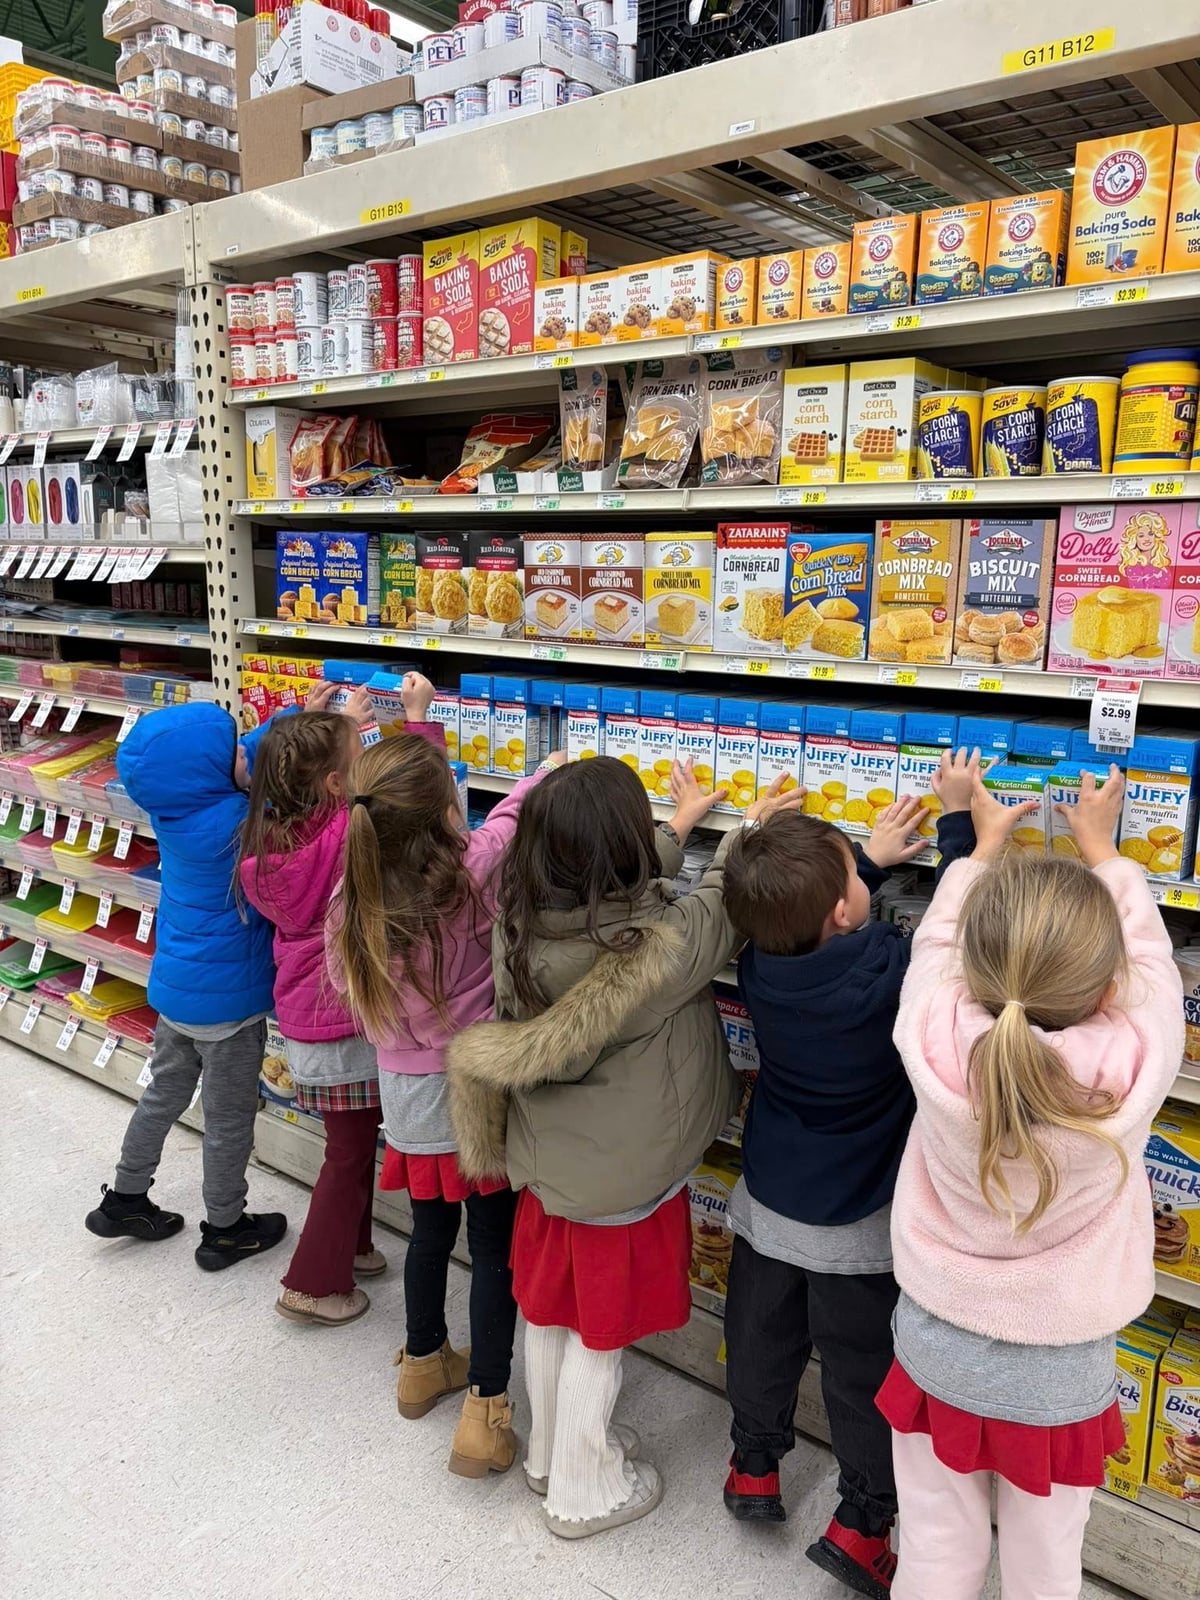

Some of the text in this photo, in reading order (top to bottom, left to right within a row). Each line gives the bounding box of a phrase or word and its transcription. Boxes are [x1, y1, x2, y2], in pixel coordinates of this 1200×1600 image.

[1023, 35, 1095, 66] G11 B12
[425, 107, 447, 121] PET
[1096, 165, 1108, 187] ARM
[1116, 154, 1144, 181] HAMMER
[370, 201, 403, 220] G11 B13
[1104, 210, 1126, 223] pure
[1075, 216, 1156, 238] Baking Soda
[484, 239, 507, 258] Save
[999, 245, 1042, 258] Baking Soda
[1086, 250, 1104, 259] 100+
[929, 255, 970, 266] Baking Soda
[1086, 256, 1104, 266] USES
[489, 253, 527, 284] BAKING
[434, 264, 471, 293] BAKING
[501, 270, 530, 296] SODA
[670, 276, 697, 289] baking
[445, 281, 472, 305] SODA
[626, 285, 651, 297] baking
[673, 286, 692, 296] soda
[807, 283, 842, 296] Baking Soda
[1118, 288, 1136, 301] $2.39
[587, 294, 612, 305] baking
[630, 294, 647, 303] soda
[762, 292, 780, 301] Baking
[542, 300, 566, 310] baking
[546, 307, 562, 316] soda
[590, 301, 607, 311] soda
[897, 316, 912, 327] $1.29
[708, 370, 778, 391] CORN BREAD
[876, 381, 896, 389] Choice
[799, 403, 825, 413] corn
[865, 398, 893, 409] corn
[992, 396, 1018, 411] Save
[859, 408, 897, 421] starch
[1008, 409, 1035, 426] CORN
[1056, 401, 1083, 421] CORN
[794, 413, 829, 425] starch
[932, 414, 958, 431] CORN
[1047, 415, 1085, 438] STARCH
[923, 426, 960, 447] STARCH
[997, 424, 1037, 443] STARCH
[1155, 483, 1175, 495] $2.59
[1077, 510, 1111, 522] Duncan
[1080, 517, 1109, 528] Hines
[728, 527, 787, 538] ZATARAIN'S
[427, 545, 460, 553] RED LOBSTER
[900, 537, 932, 548] LOUISIANA
[989, 537, 1023, 548] LOUISIANA
[1060, 532, 1120, 563] Dolly
[492, 545, 515, 554] LOBSTER
[723, 557, 780, 573] CORNBREAD
[803, 559, 825, 573] Quick
[836, 554, 855, 565] Easy
[877, 557, 953, 578] CORNBREAD
[969, 559, 1040, 579] BISCUIT
[280, 567, 320, 577] CORN BREAD
[323, 568, 362, 579] CORN BREAD
[743, 572, 757, 582] MIX
[790, 563, 863, 594] Corn Bread
[1059, 574, 1121, 583] CORNBREAD
[531, 575, 571, 586] CORNBREAD MIX
[588, 576, 633, 589] CORNBREAD MIX
[653, 578, 701, 589] CORNBREAD MIX
[899, 575, 926, 590] MIX
[988, 576, 1016, 592] MIX
[827, 585, 848, 598] Mix
[894, 592, 930, 601] HOMESTYLE
[980, 594, 1022, 604] BUTTERMILK
[248, 685, 264, 696] CORN
[431, 703, 458, 716] JIFFY
[461, 707, 488, 720] JIFFY
[1101, 707, 1131, 719] $2.99
[496, 710, 524, 724] JIFFY
[569, 720, 597, 734] JIFFY
[607, 724, 638, 738] JIFFY
[360, 731, 384, 746] JIF
[641, 729, 674, 744] JIFFY
[678, 733, 713, 748] JIFFY
[719, 737, 755, 753] JIFFY
[761, 742, 798, 758] JIFFY
[806, 747, 847, 764] JIFFY
[851, 753, 895, 770] JIFFY
[901, 757, 941, 774] JIFF
[863, 775, 878, 783] mix
[868, 768, 892, 778] muffin
[1145, 773, 1171, 782] Honey
[993, 780, 1033, 790] Vegetarian
[1127, 784, 1186, 805] JIFFY
[1150, 809, 1178, 820] muffin
[1161, 1152, 1190, 1166] WATER
[1134, 1366, 1146, 1375] 30
[1114, 1476, 1131, 1491] $2.99
